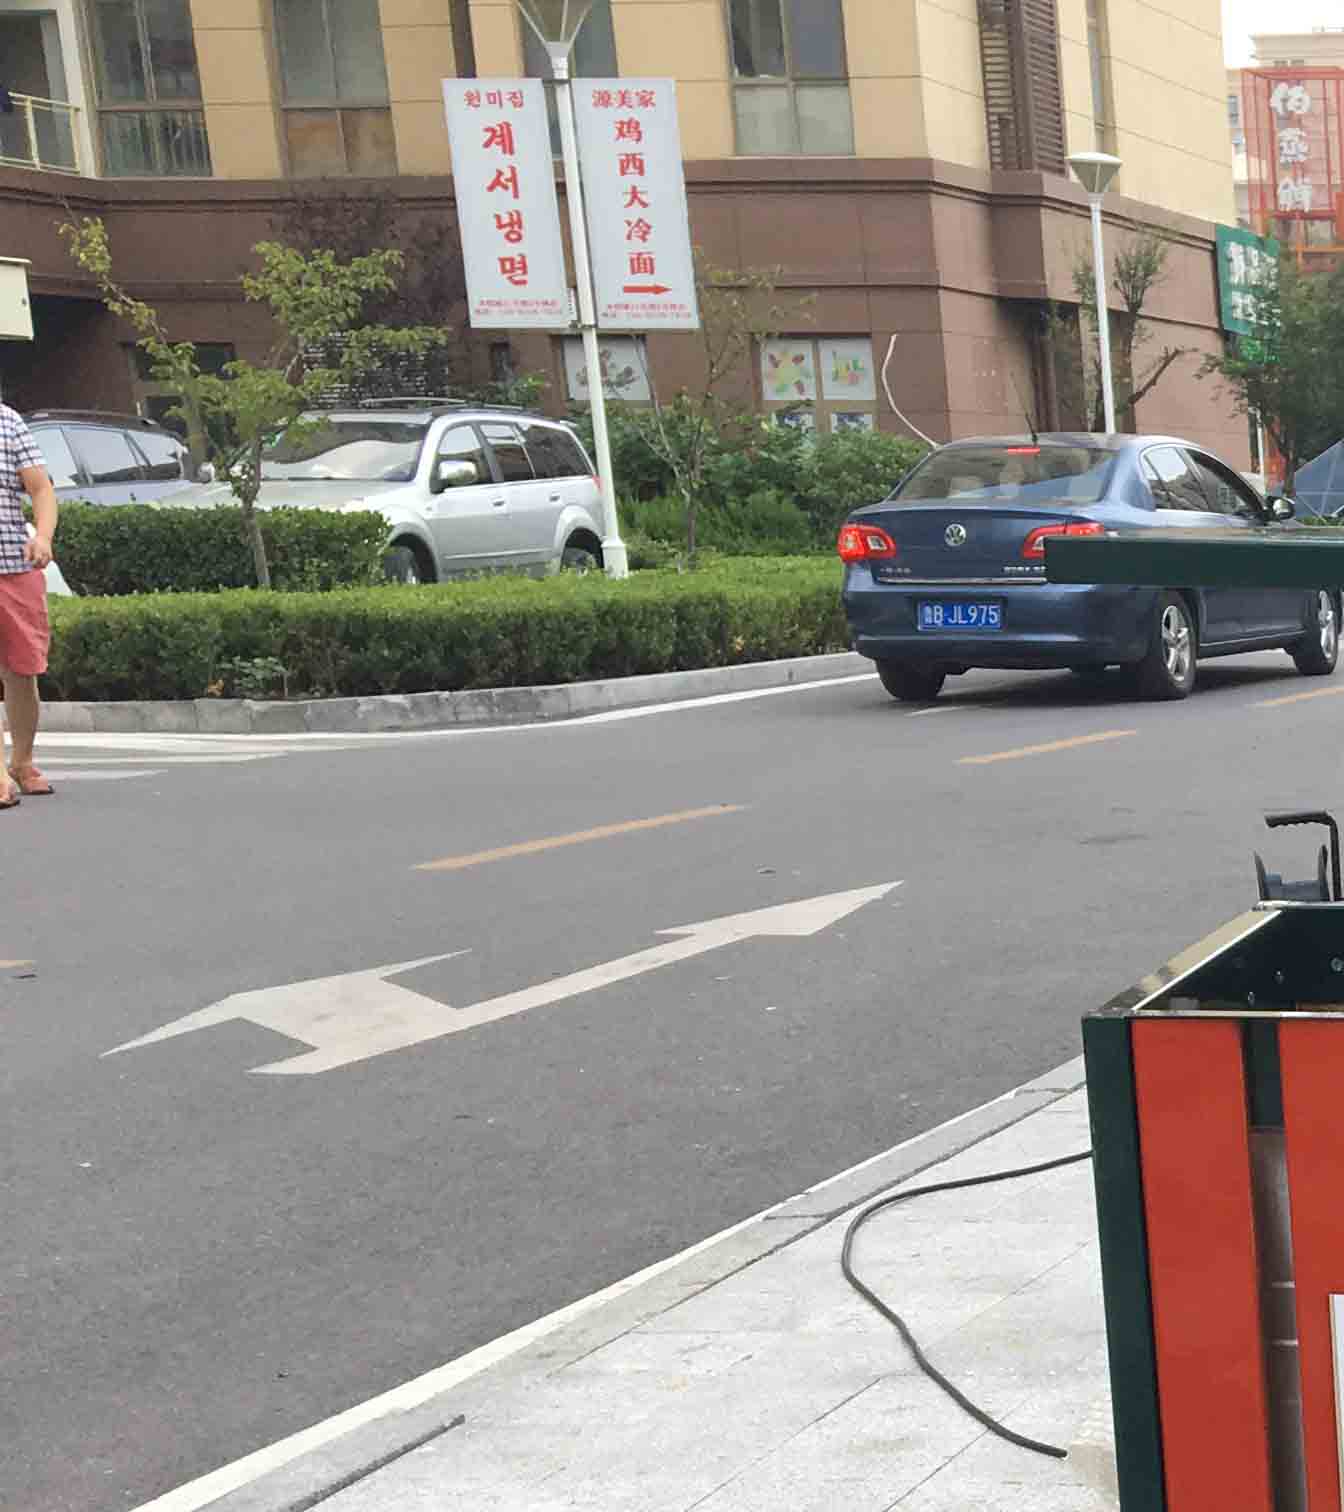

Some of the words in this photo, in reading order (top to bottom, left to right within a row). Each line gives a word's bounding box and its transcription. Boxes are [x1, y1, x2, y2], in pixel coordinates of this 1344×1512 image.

[482, 121, 528, 286] 계서냉면
[614, 117, 656, 276] 鸡西大冷面
